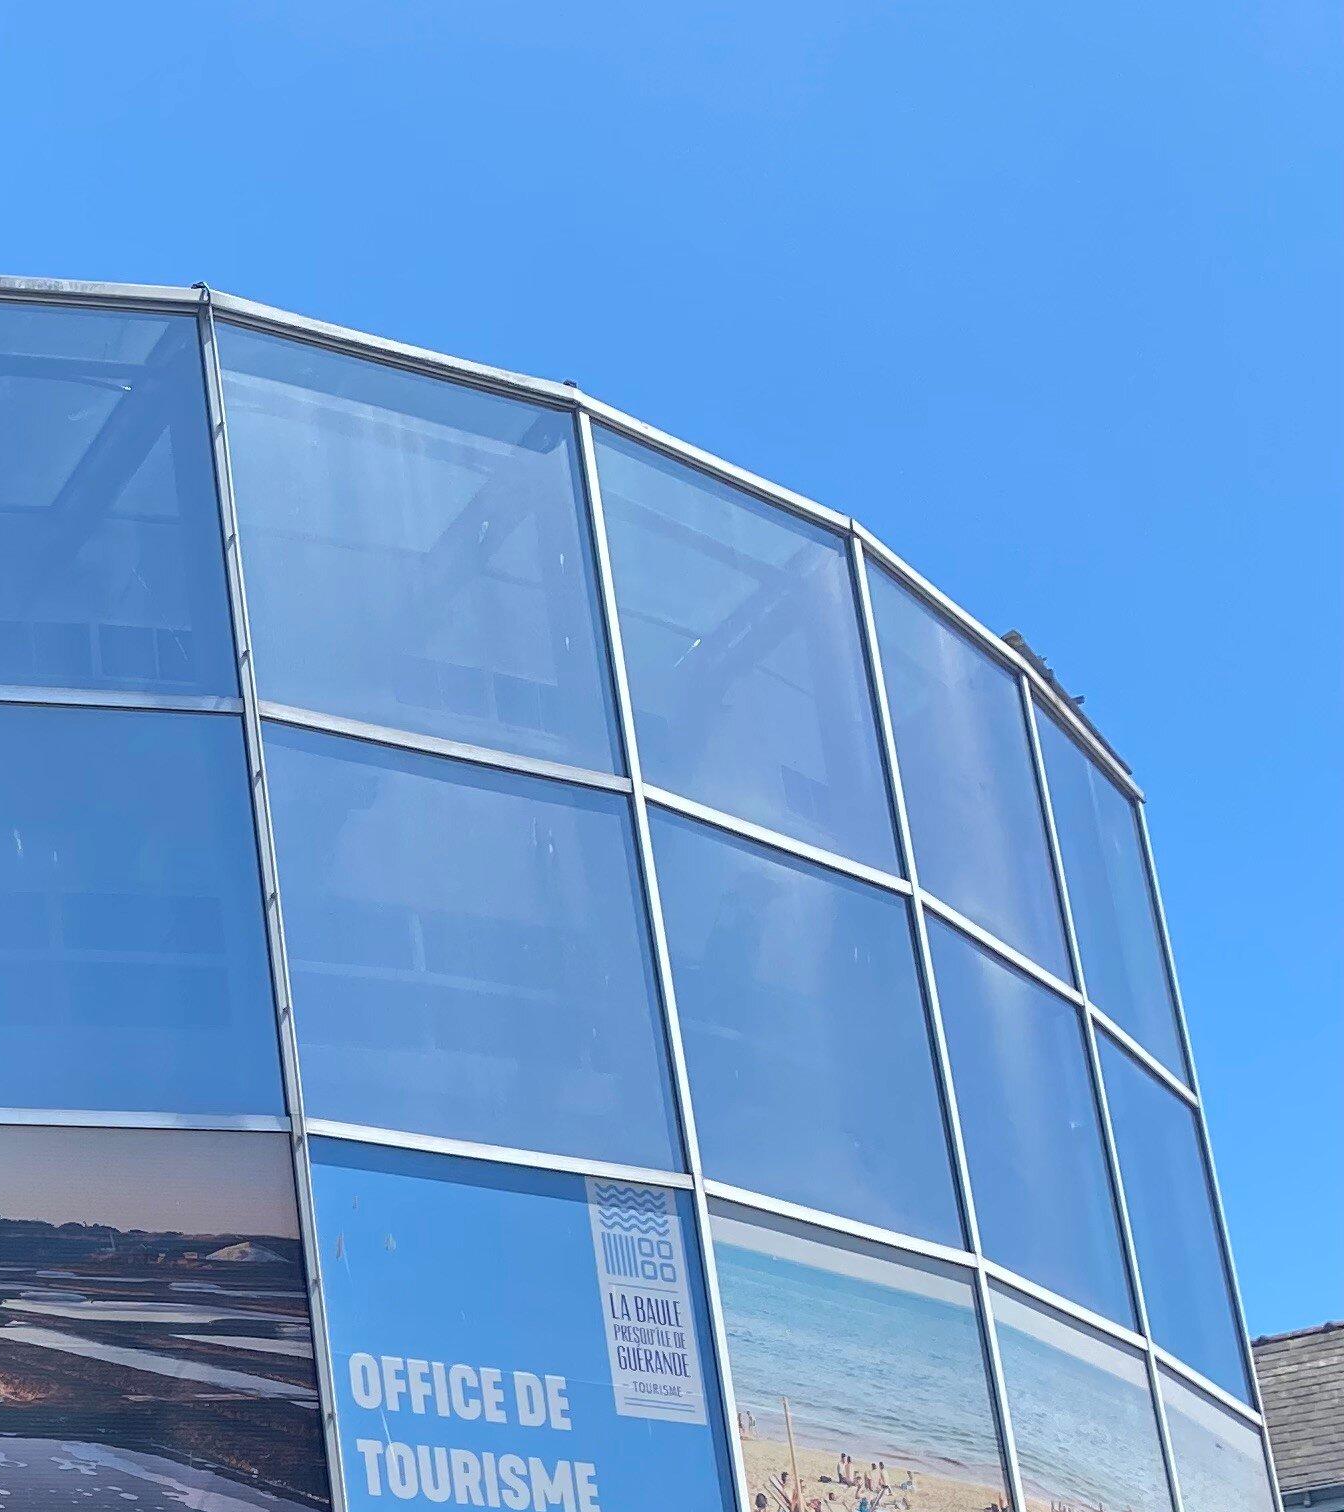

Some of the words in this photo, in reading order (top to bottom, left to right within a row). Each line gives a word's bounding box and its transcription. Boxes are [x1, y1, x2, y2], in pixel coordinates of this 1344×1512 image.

[609, 1292, 631, 1321] LA
[634, 1296, 683, 1328] BAULE
[674, 1331, 686, 1349] DE
[617, 1345, 691, 1378] GUÉRANDE
[349, 1352, 507, 1424] OFFICE
[513, 1371, 572, 1431] DE
[632, 1381, 683, 1397] TOURISME
